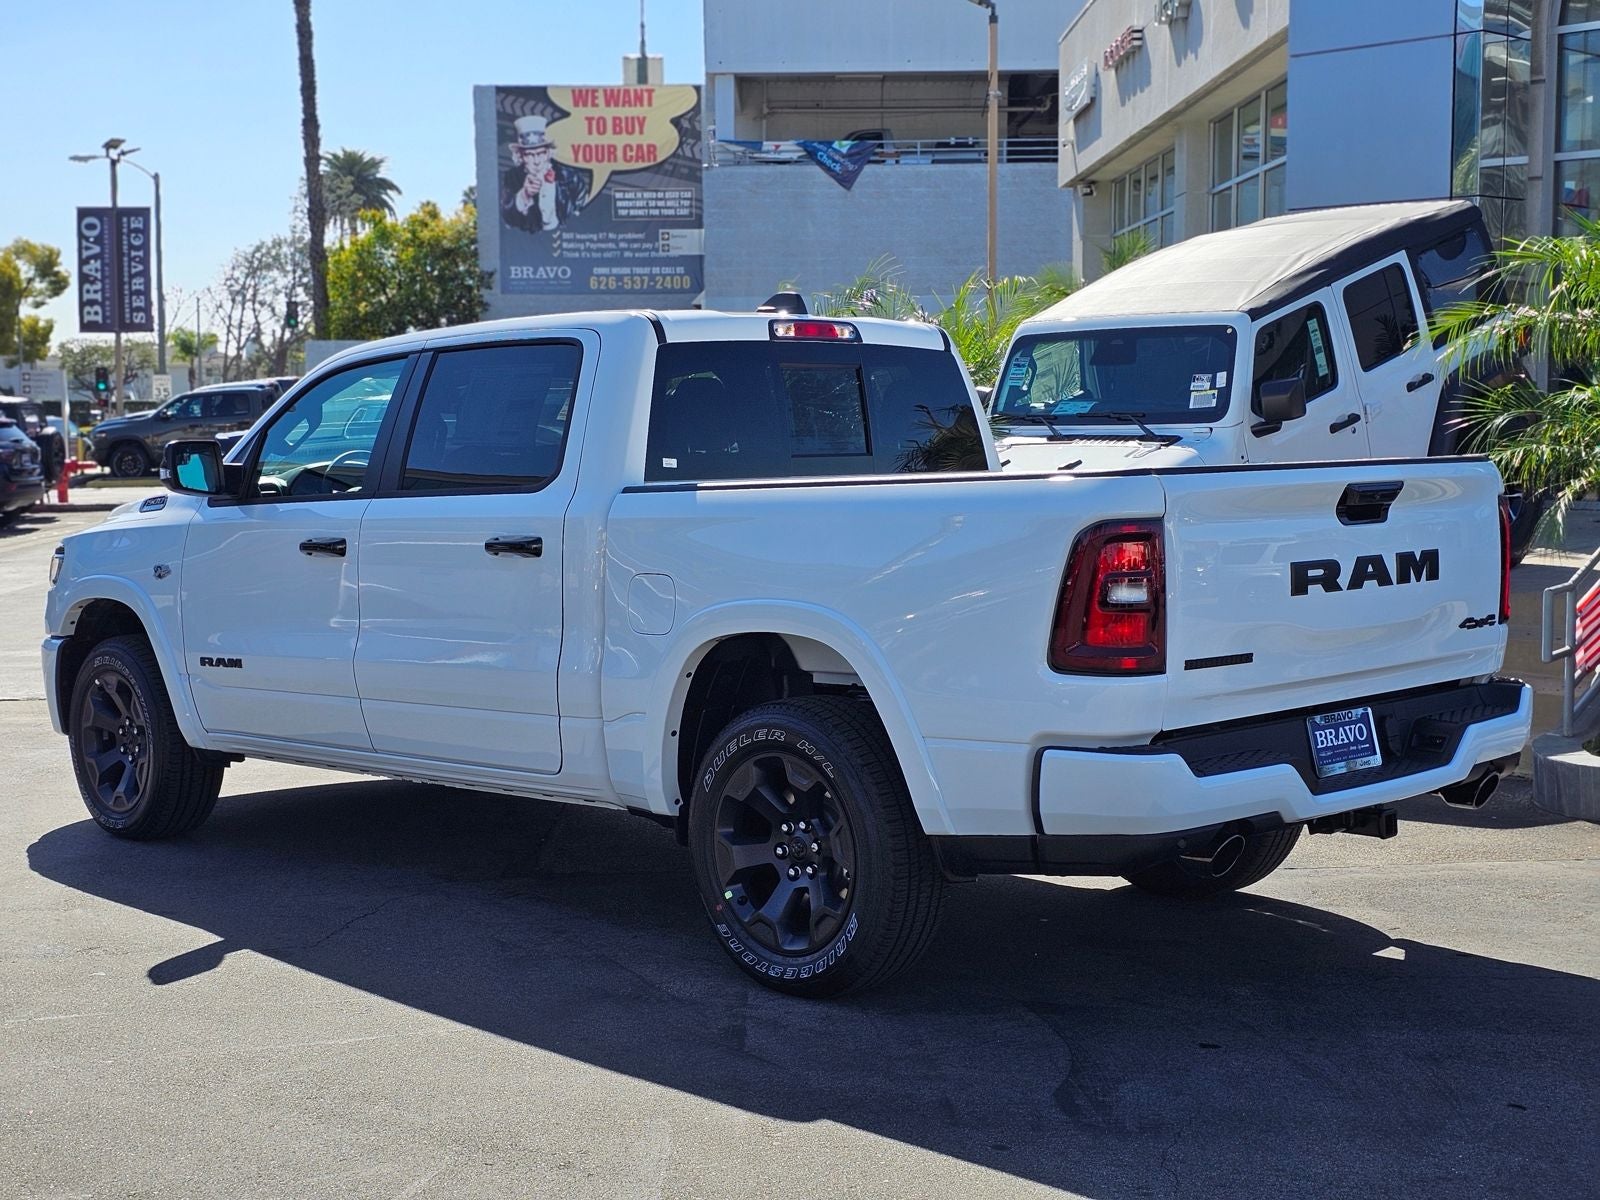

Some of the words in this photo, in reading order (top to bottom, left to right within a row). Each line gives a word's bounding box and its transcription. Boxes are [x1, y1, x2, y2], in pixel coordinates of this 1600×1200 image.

[571, 88, 599, 108] WE
[603, 88, 655, 108] WANT
[584, 116, 607, 136] TO
[612, 116, 646, 136] BUY
[571, 144, 617, 163] YOUR
[622, 144, 657, 163] CAR
[81, 216, 102, 324] BRAVO
[130, 216, 146, 324] SERVICE
[510, 266, 571, 279] BRAVO
[590, 276, 691, 289] 626-537-2400
[1290, 548, 1440, 596] RAM
[200, 656, 243, 669] RAM
[1324, 711, 1353, 723] BRAVO
[1315, 723, 1367, 748] BRAVO
[703, 729, 787, 793] DUELER
[797, 740, 835, 779] H/L
[717, 912, 859, 980] BRIDGESTONE
